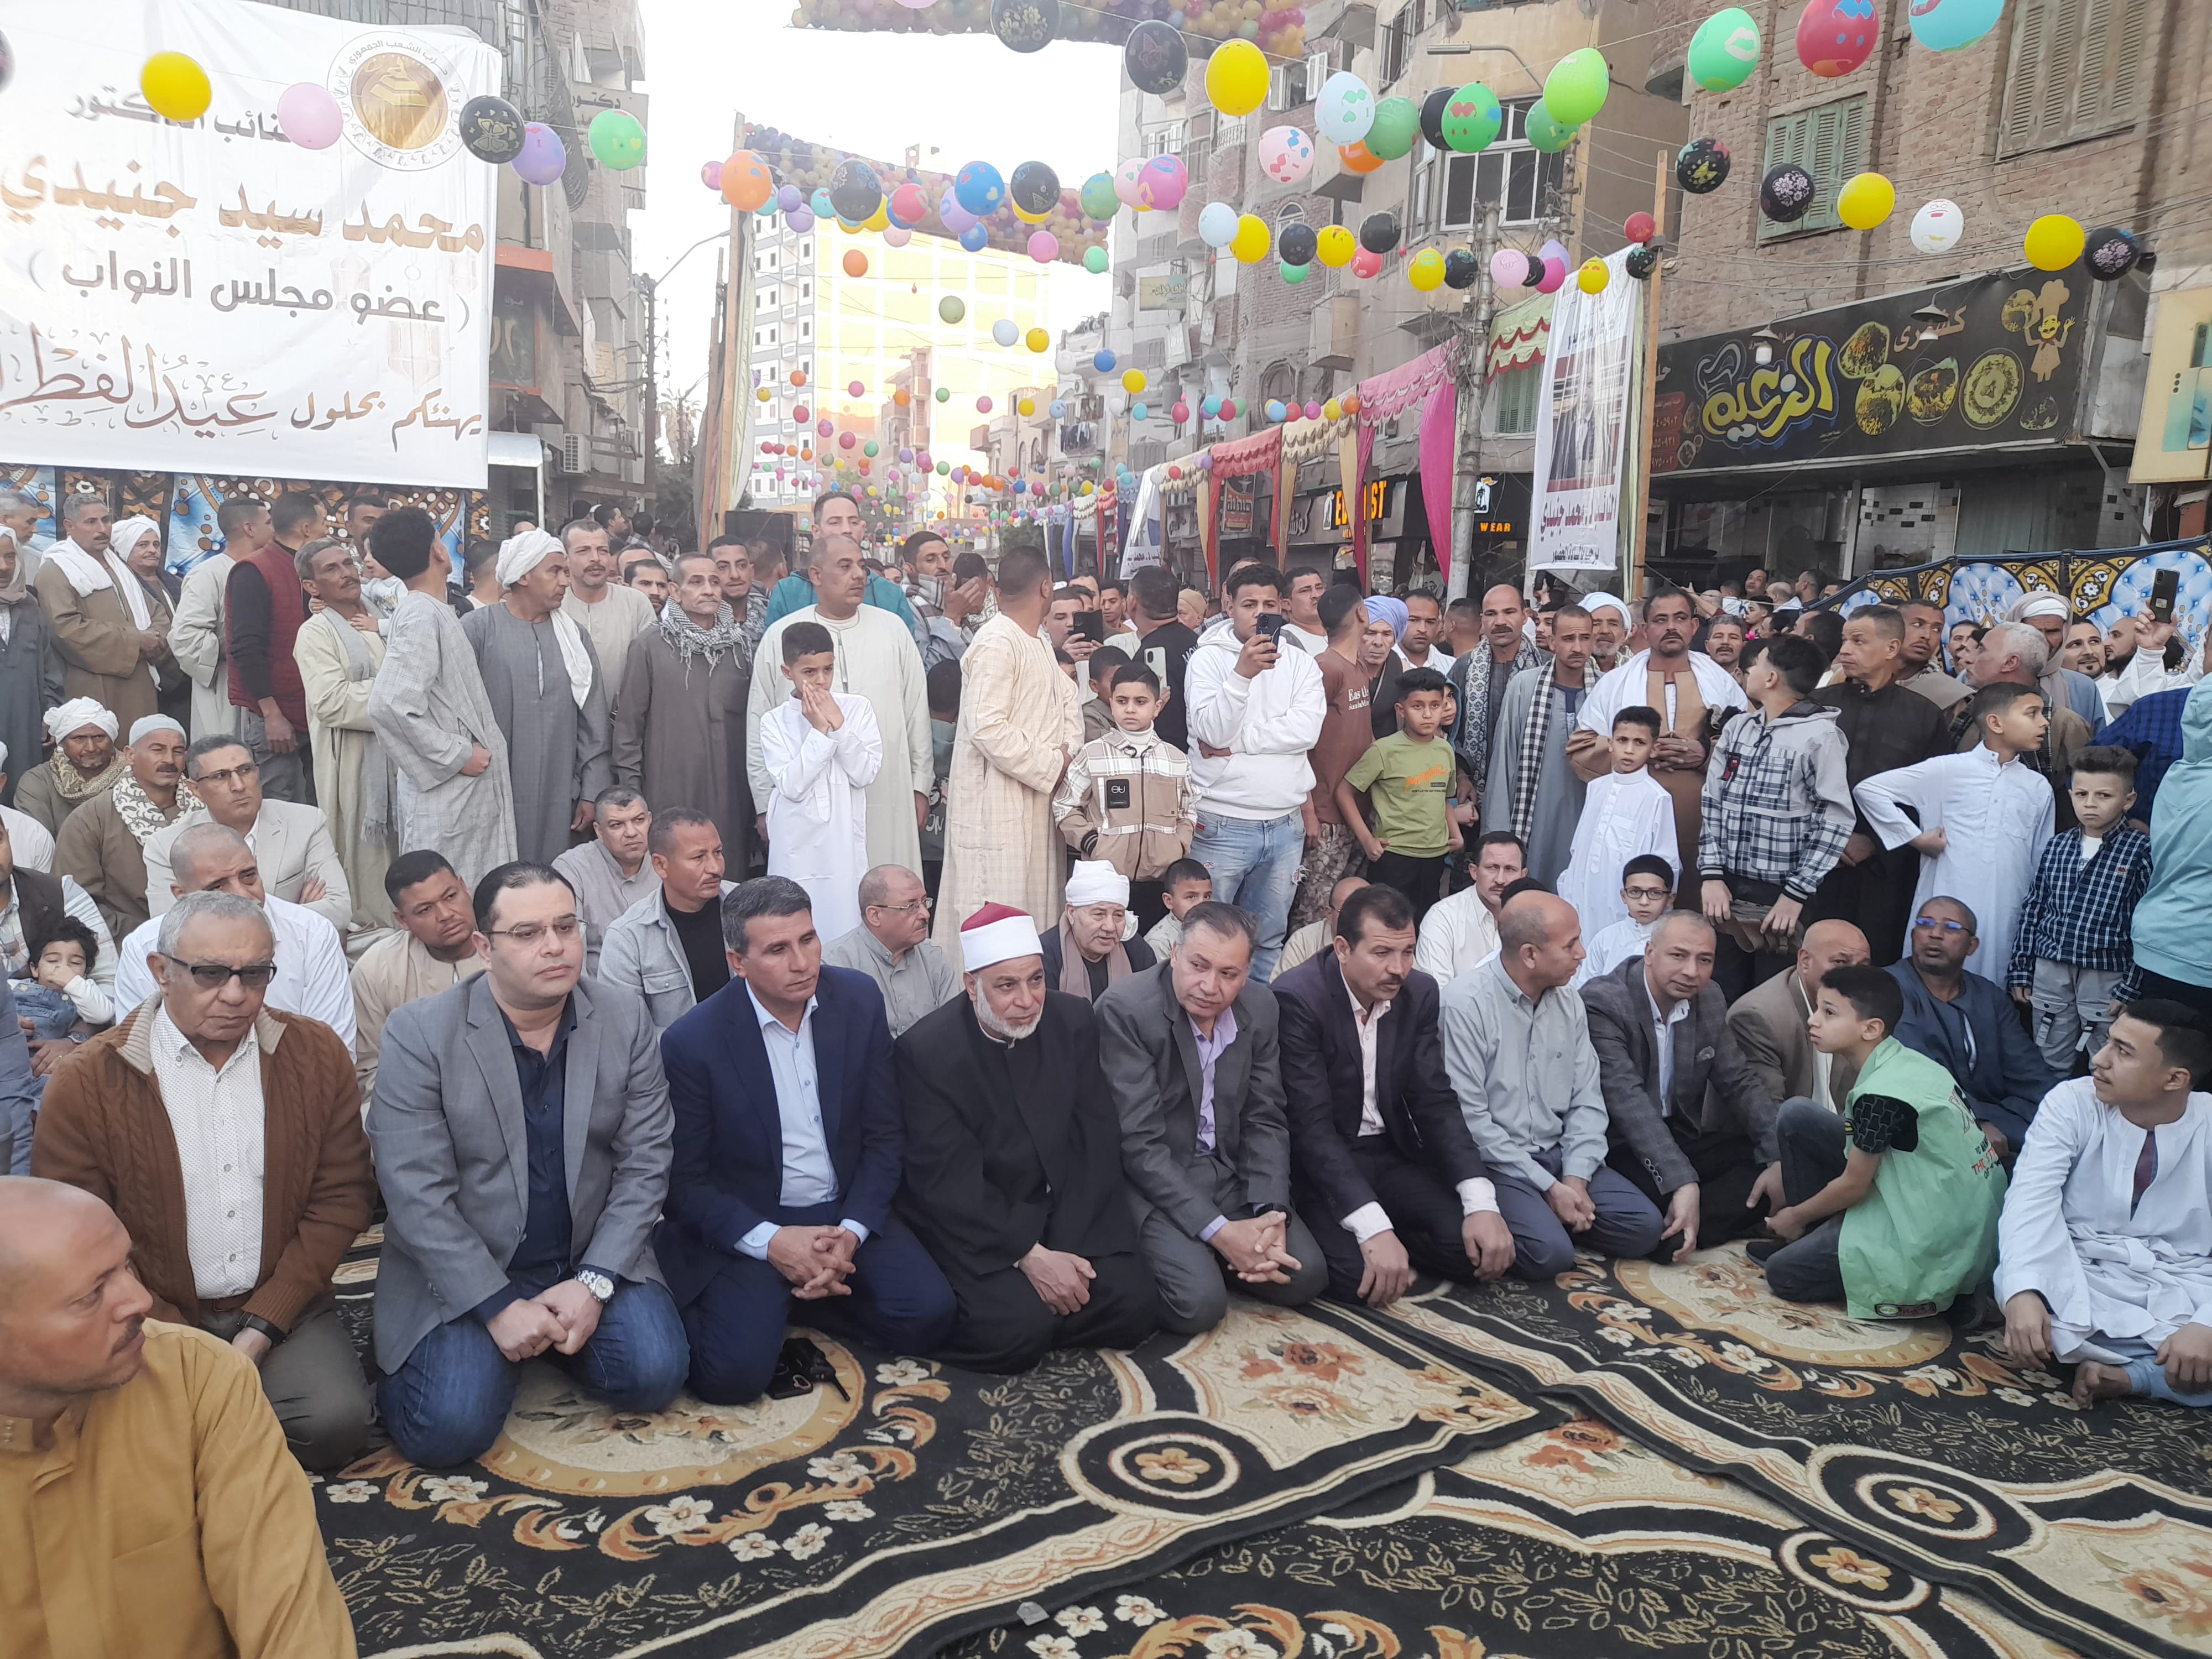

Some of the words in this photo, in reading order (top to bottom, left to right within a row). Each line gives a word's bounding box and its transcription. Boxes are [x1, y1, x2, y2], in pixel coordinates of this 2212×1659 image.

[348, 39, 384, 65] الجمهوري
[385, 41, 422, 54] الشعب
[1, 154, 199, 238] جنيدي
[218, 181, 323, 250] سيد
[342, 197, 485, 254] محمد
[62, 249, 192, 305] النواب
[210, 268, 334, 319] مجلس
[350, 284, 445, 325] عضو
[290, 390, 387, 431] بحلول
[1702, 337, 1834, 442] الزعيم
[392, 388, 482, 453] يهنئكم
[1479, 522, 1511, 533] WEAR
